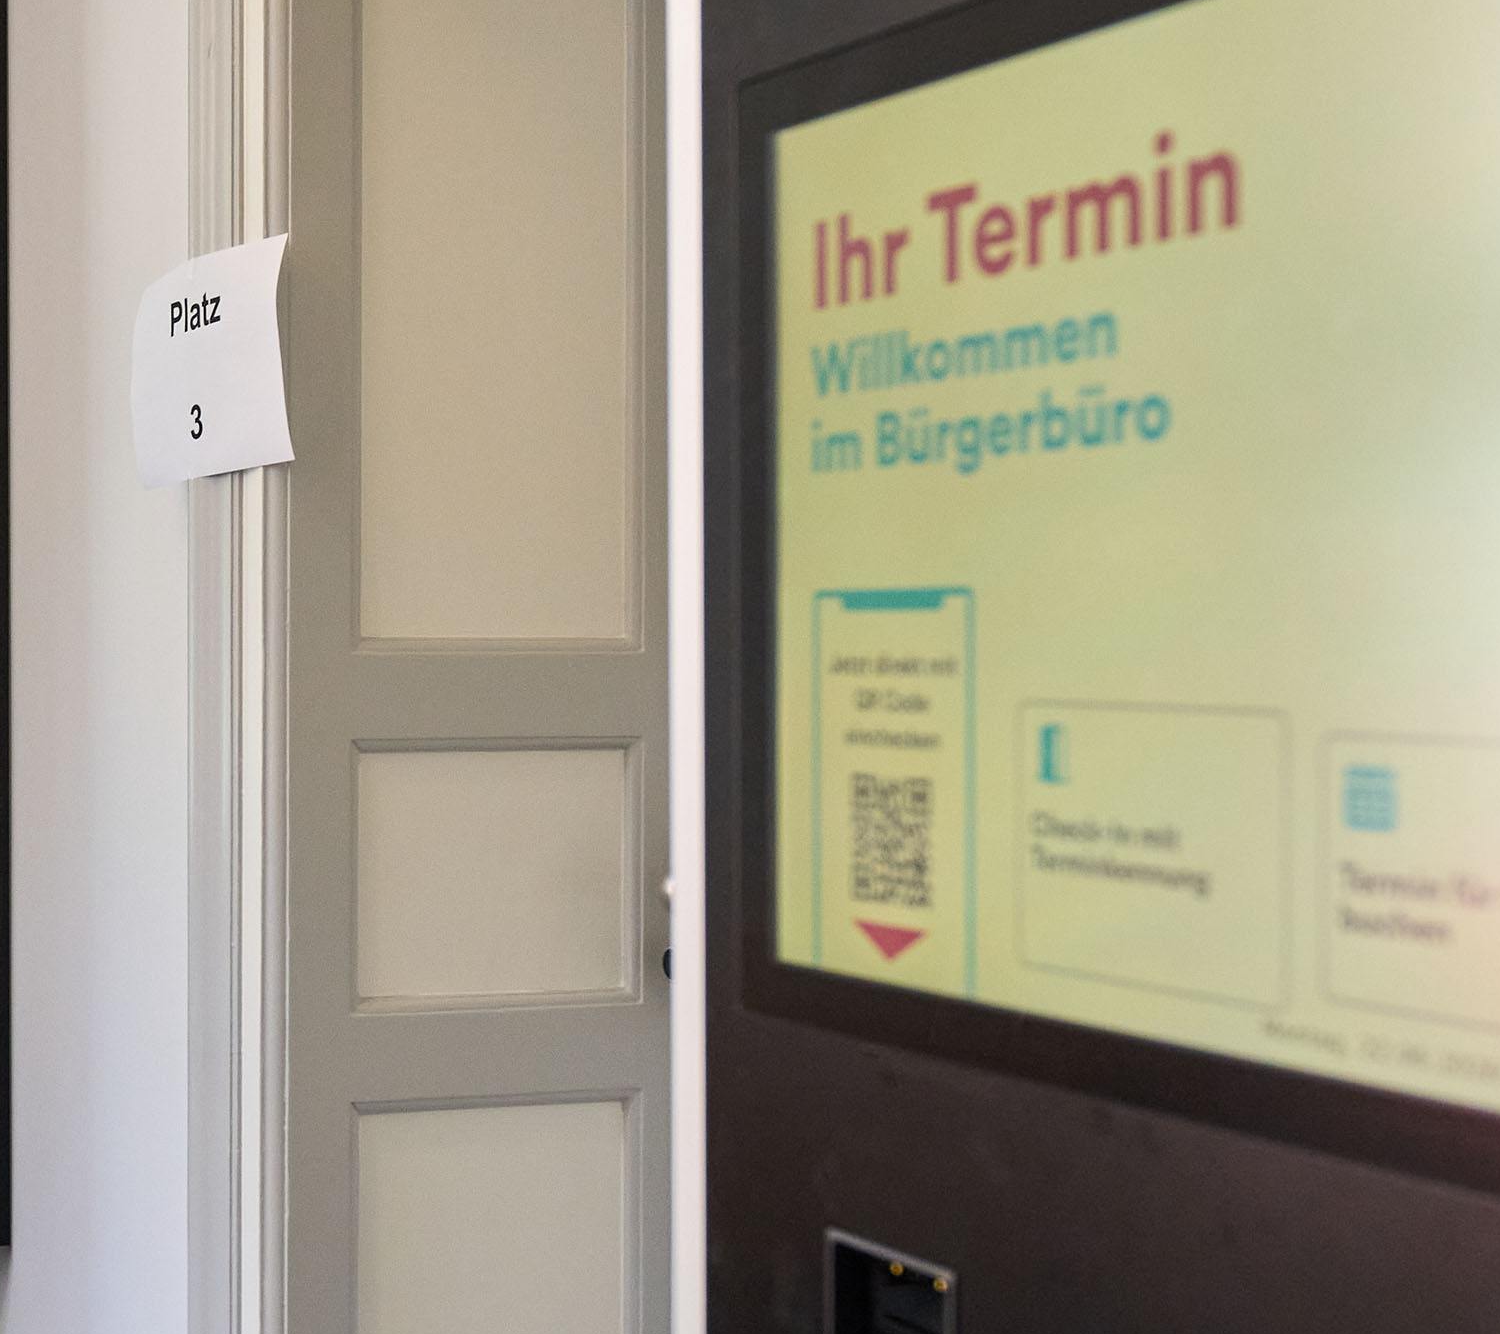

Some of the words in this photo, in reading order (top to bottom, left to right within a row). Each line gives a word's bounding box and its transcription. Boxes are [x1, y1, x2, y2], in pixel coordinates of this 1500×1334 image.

[812, 212, 911, 311] Ihr
[927, 131, 1241, 287] Termin
[170, 292, 221, 337] Platz
[811, 309, 1119, 398] Willkommen
[190, 404, 203, 439] 3
[810, 415, 862, 475] im
[874, 385, 1172, 477] Bürgerbüro
